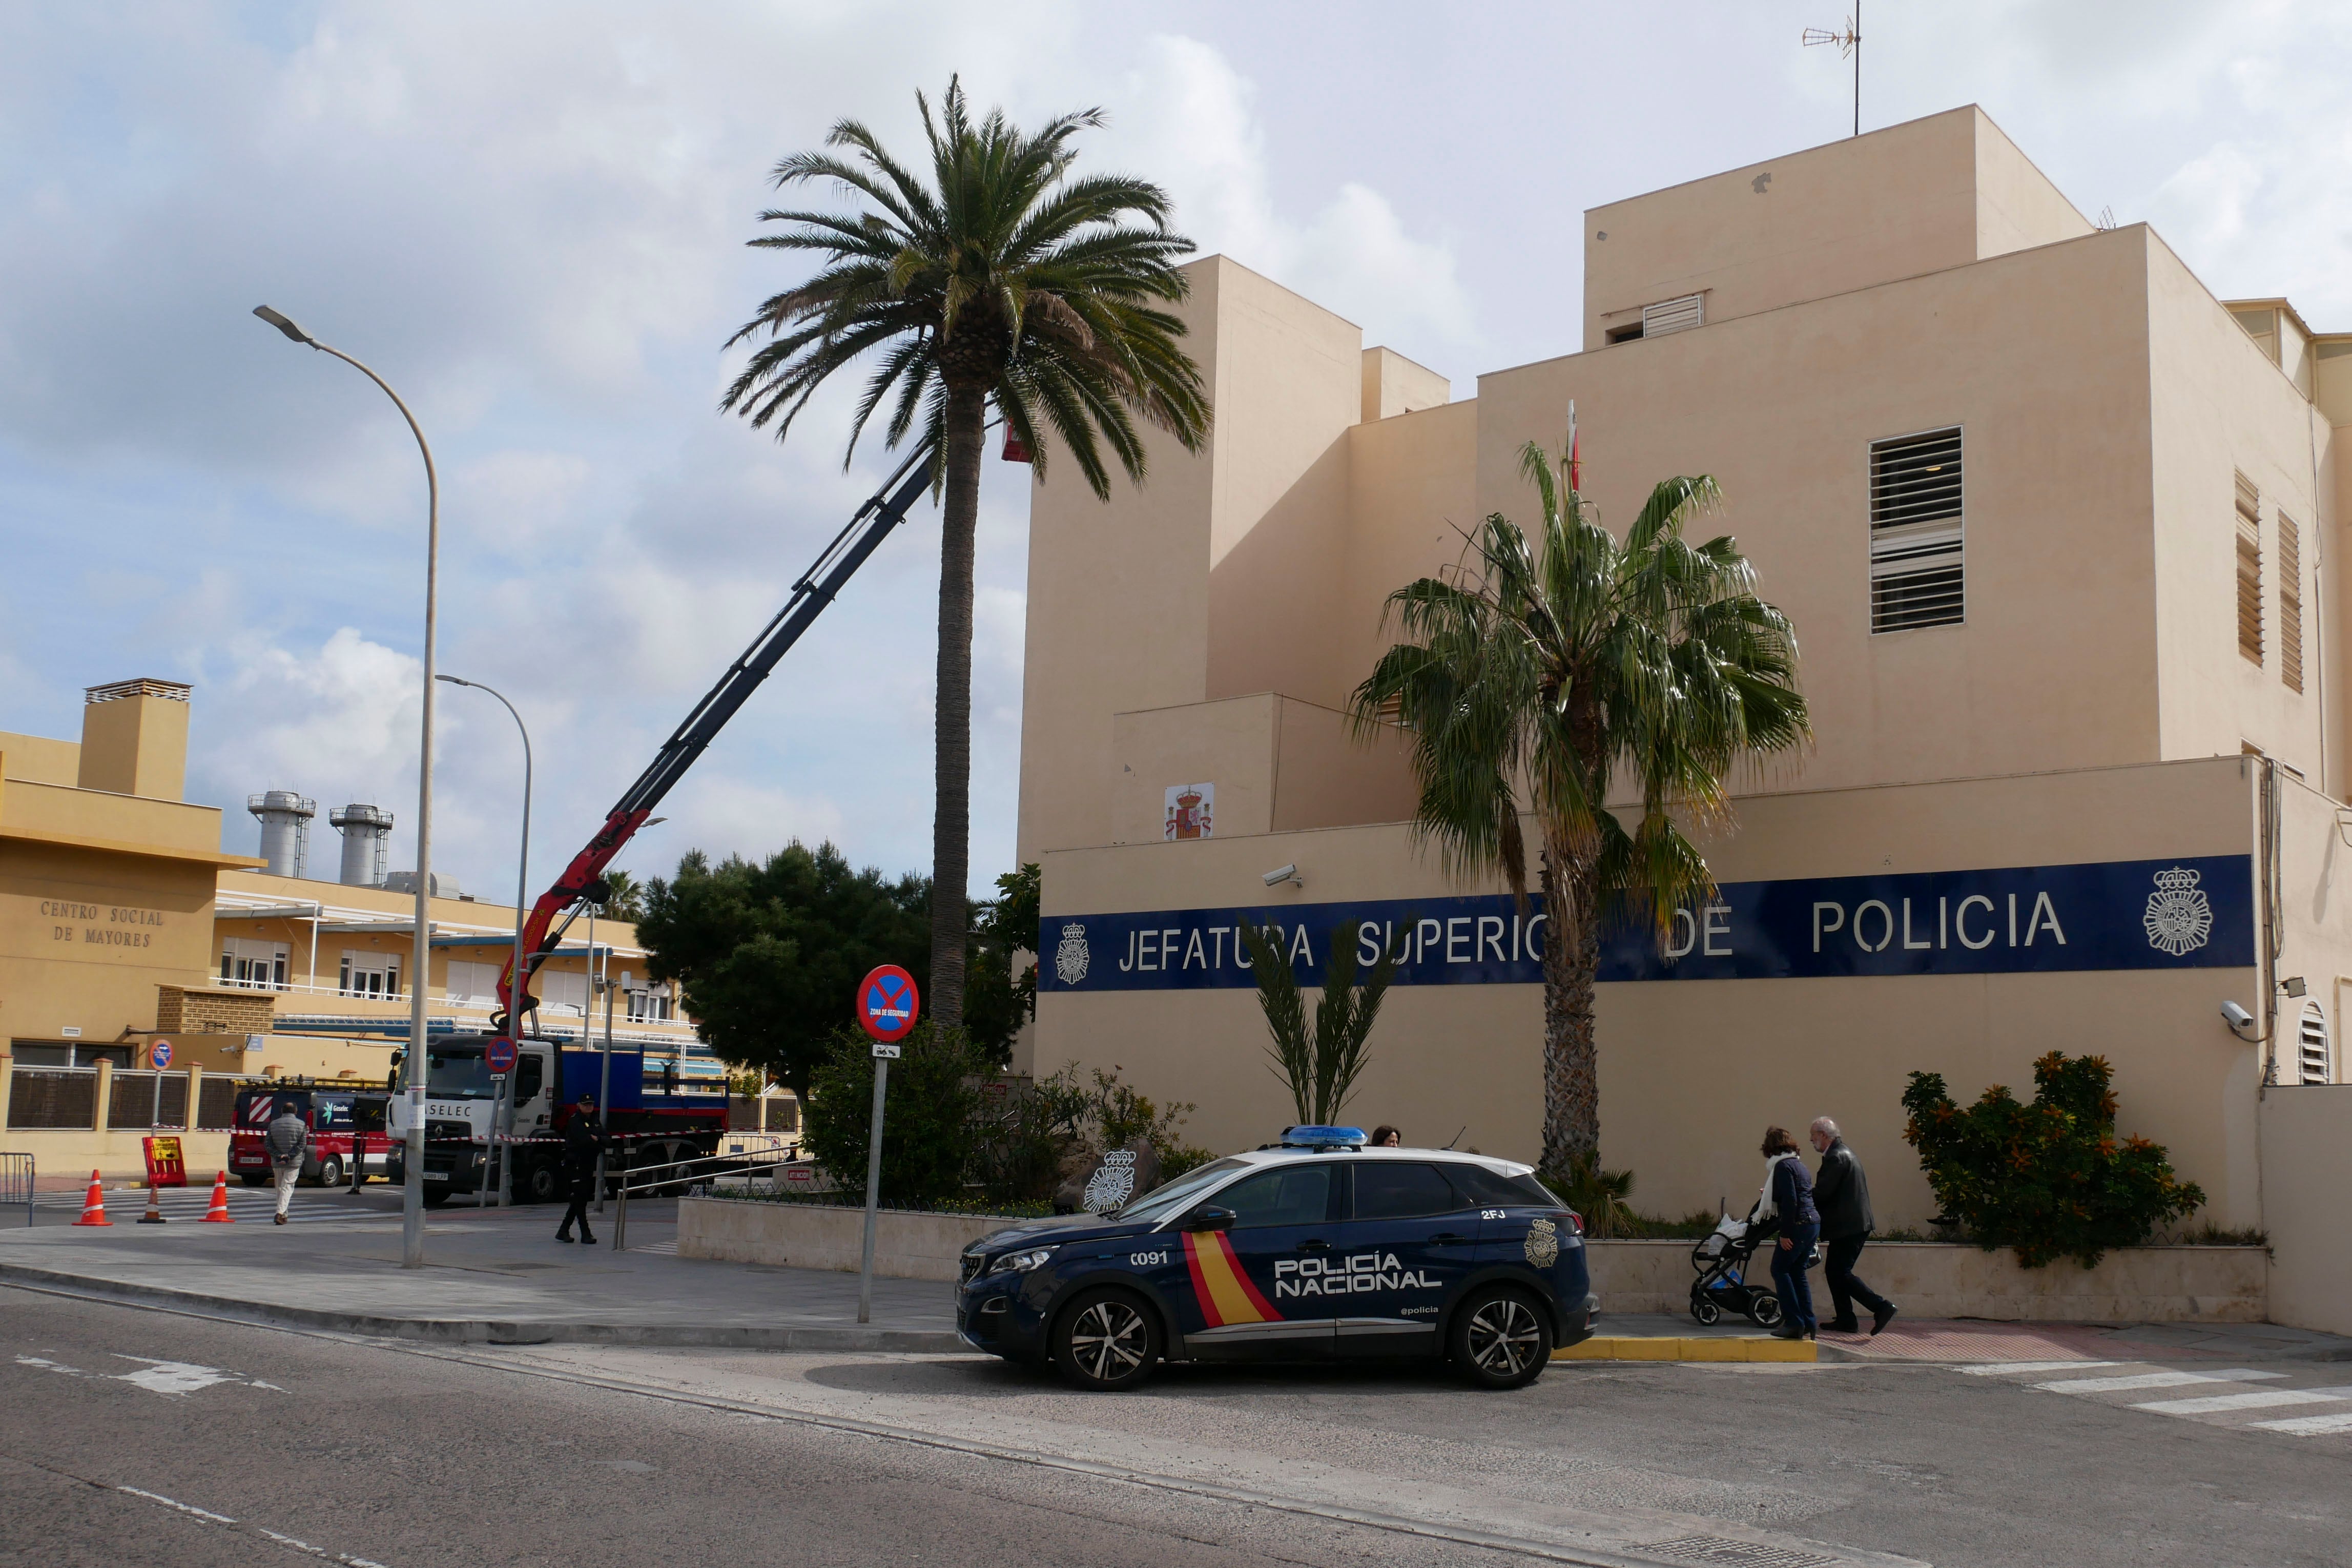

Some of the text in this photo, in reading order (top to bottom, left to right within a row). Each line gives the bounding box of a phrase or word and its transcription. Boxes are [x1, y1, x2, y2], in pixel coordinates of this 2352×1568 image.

[41, 901, 163, 926] CENTRO SOCIAL
[54, 926, 150, 948] DE MAYORES
[1119, 924, 1314, 972] JEFATURA
[1665, 906, 1732, 957] DE
[1813, 891, 2066, 954] POLICIA
[1481, 1210, 1506, 1220] 2FJ
[1274, 1250, 1402, 1278] POLICÍA
[1275, 1270, 1442, 1298] NACIONAL
[1400, 1305, 1439, 1316] @policia
